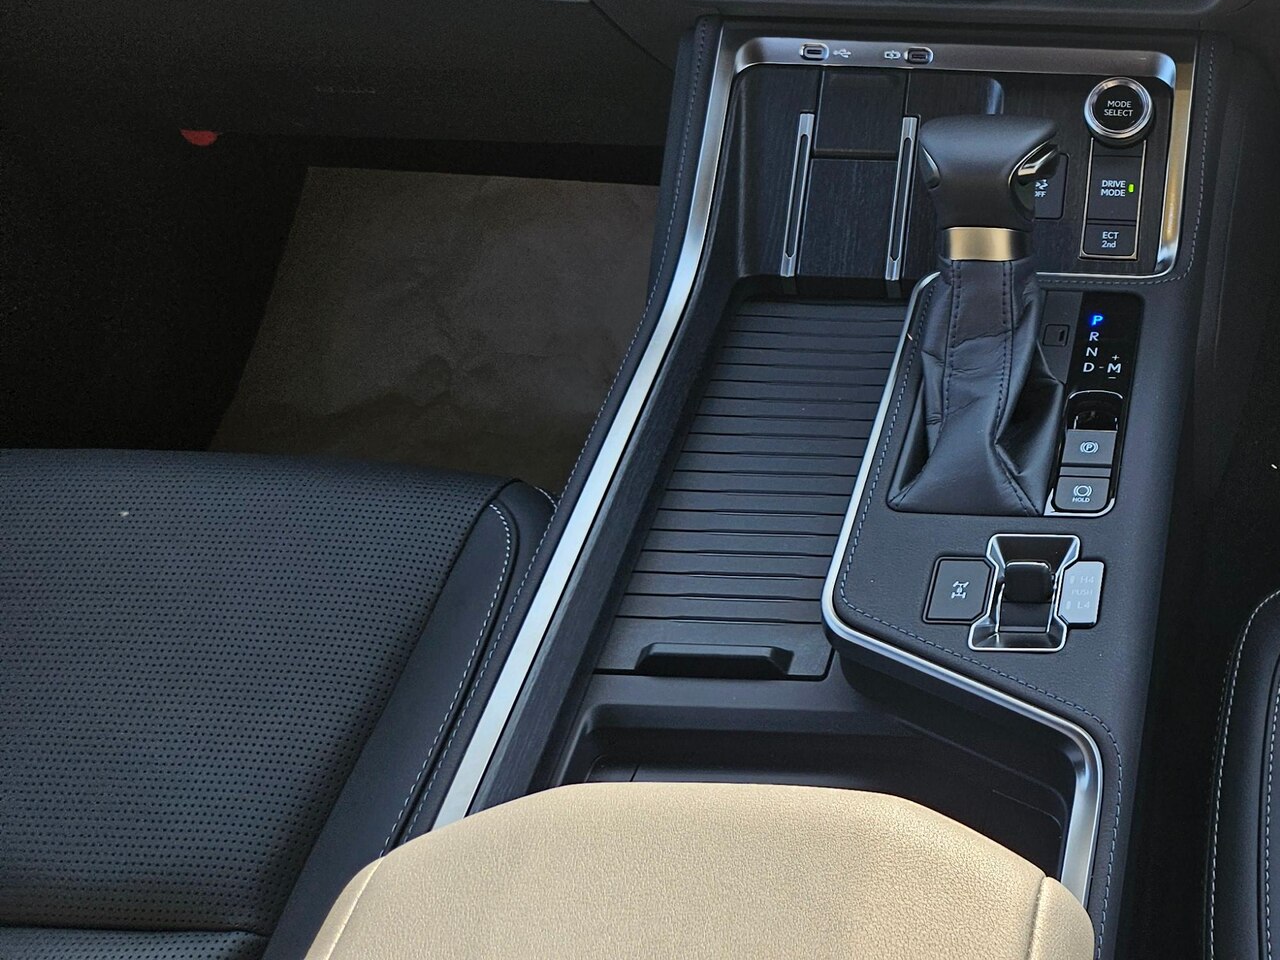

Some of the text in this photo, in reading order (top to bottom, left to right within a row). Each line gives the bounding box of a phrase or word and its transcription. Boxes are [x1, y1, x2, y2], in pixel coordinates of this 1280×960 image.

[1107, 100, 1132, 108] MODE
[1104, 108, 1133, 117] SELECT
[1101, 180, 1126, 188] DRIVE
[1100, 188, 1126, 197] MODE
[1102, 231, 1119, 240] ECT
[1101, 240, 1117, 248] 2nd
[1092, 315, 1103, 326] P
[1089, 332, 1099, 342] R
[1086, 347, 1098, 357] N
[1083, 362, 1122, 373] D M
